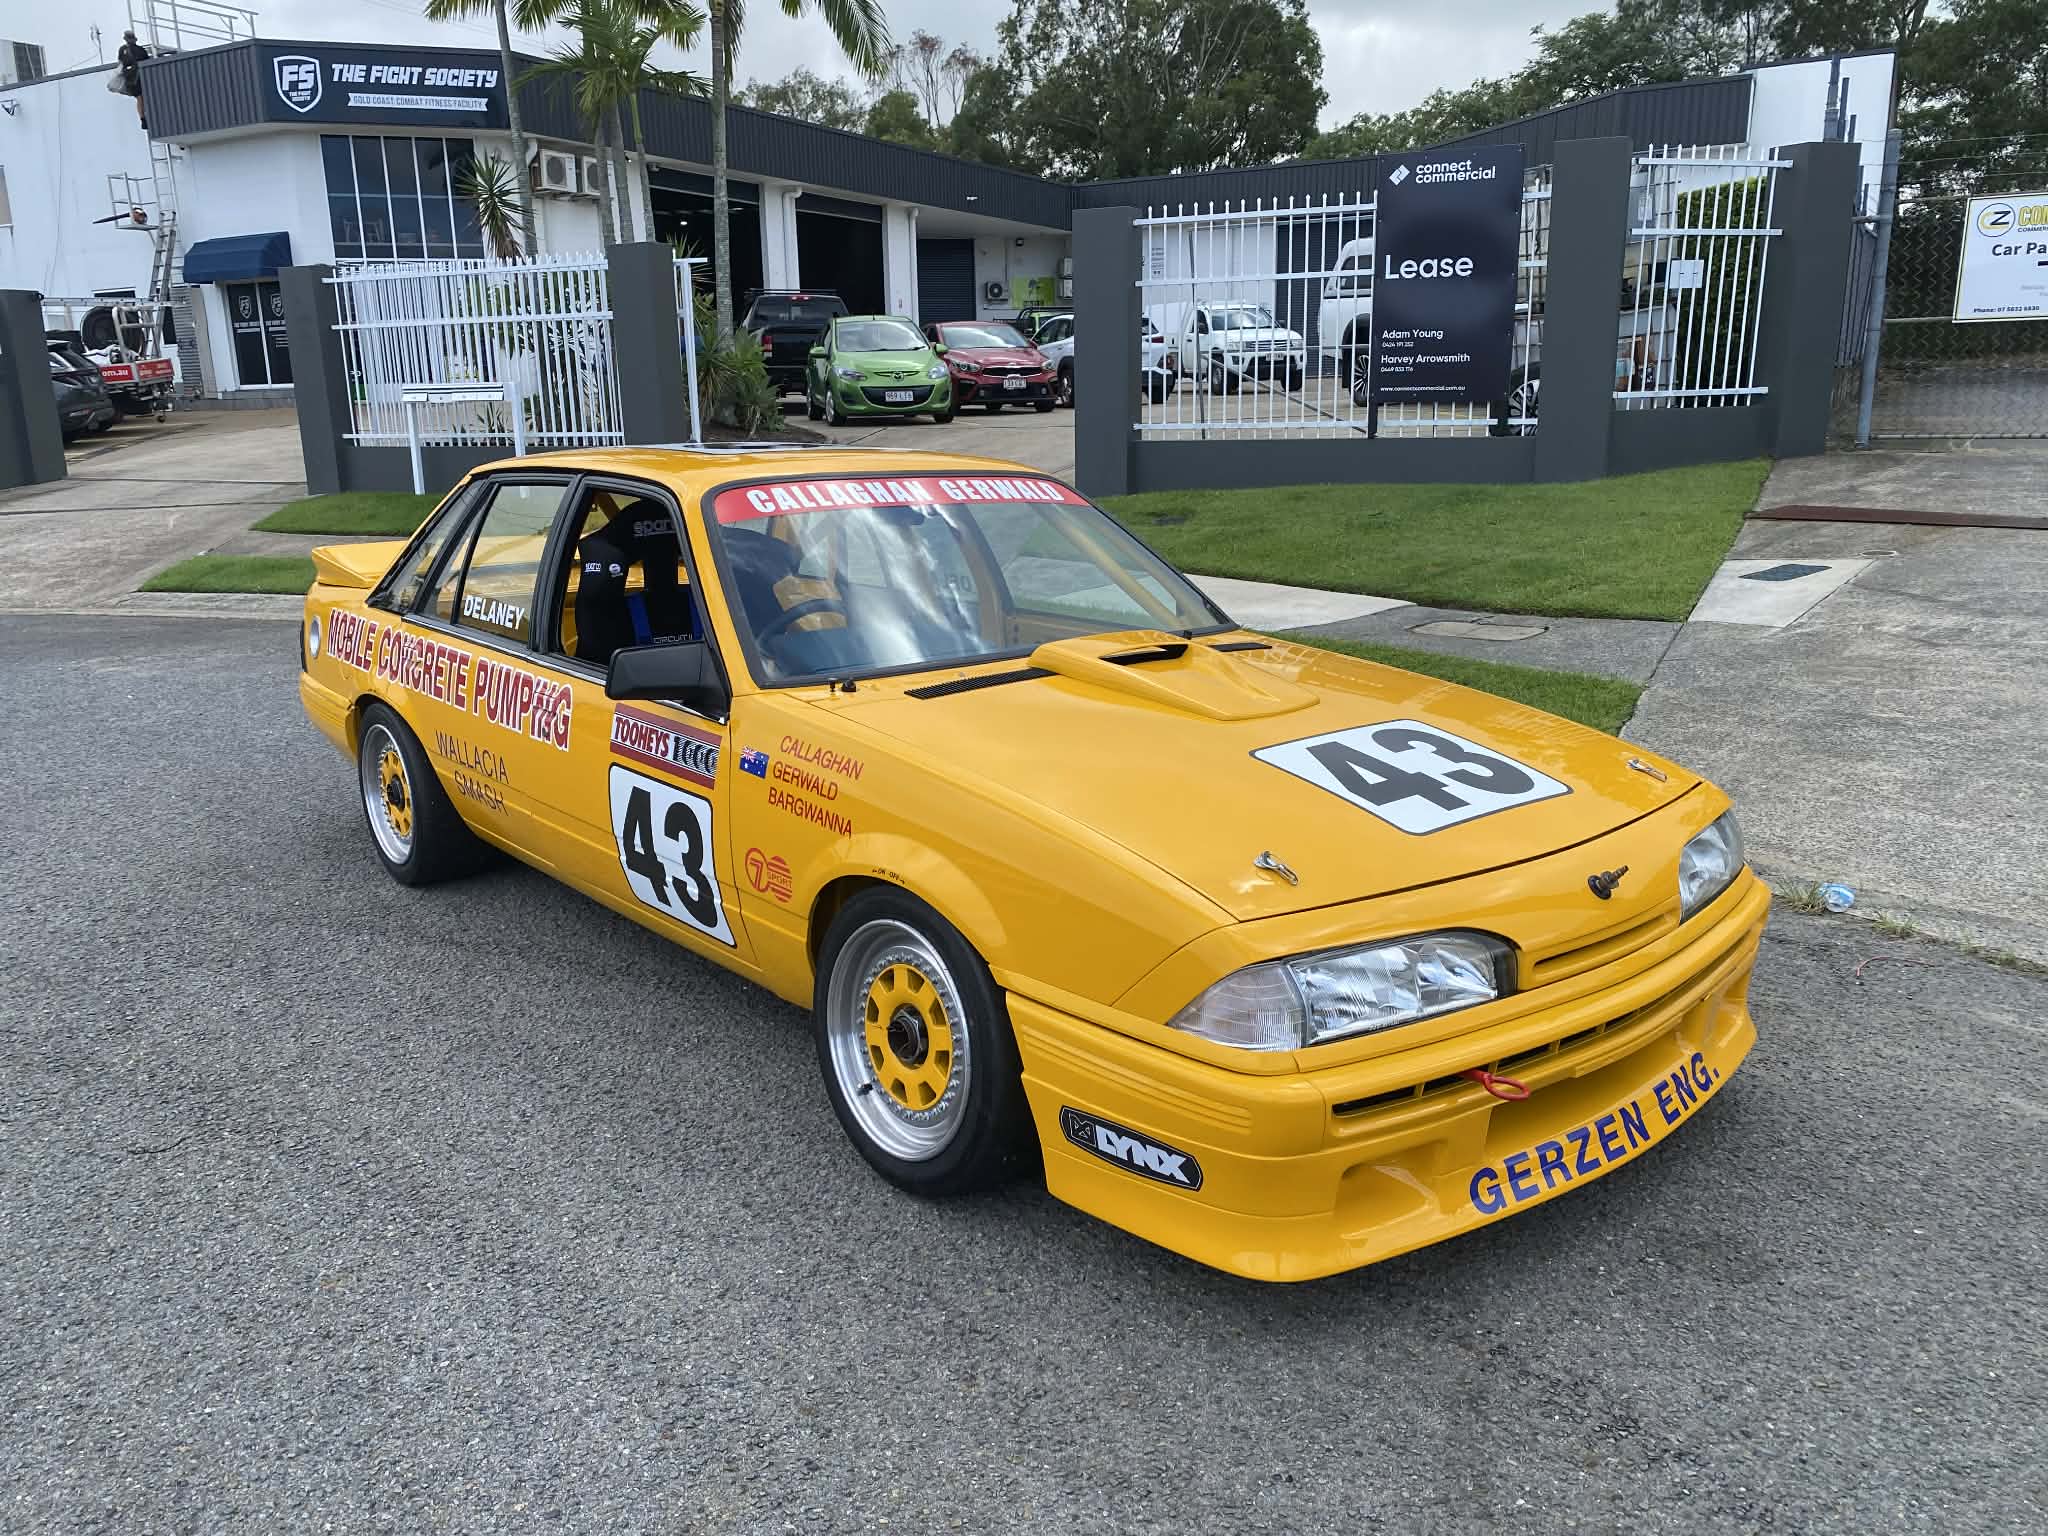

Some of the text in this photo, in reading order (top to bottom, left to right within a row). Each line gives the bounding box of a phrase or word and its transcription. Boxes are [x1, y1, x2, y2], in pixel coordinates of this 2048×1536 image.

[282, 64, 315, 91] FS
[331, 63, 499, 88] THE FIGHT SOCIETY
[353, 95, 483, 109] GOLD COAST COMBAT FITNESS FACILITY
[1415, 160, 1472, 174] connect
[1415, 166, 1496, 184] commercial
[1385, 254, 1474, 280] Lease
[1991, 243, 2023, 256] Car
[1382, 329, 1444, 340] Adam Young
[1380, 352, 1471, 365] Harvey Arrowsmith
[745, 478, 1065, 513] CALLAGHAN GERWALD
[463, 595, 525, 630] DELANEY
[327, 608, 379, 674] MOBILE
[376, 624, 474, 711] CONCRETE
[435, 730, 511, 784] WALLACIA
[614, 715, 719, 775] TOOHEYS 1000
[779, 735, 865, 782] CALLAGHAN
[772, 760, 839, 801] GERWALD
[1305, 728, 1536, 812] 43
[453, 769, 509, 817] SMASH
[768, 786, 852, 838] BARGWANNA
[622, 785, 718, 929] 43
[1469, 1051, 1721, 1215] GERZEN ENG.
[1095, 1125, 1192, 1184] LYNX
